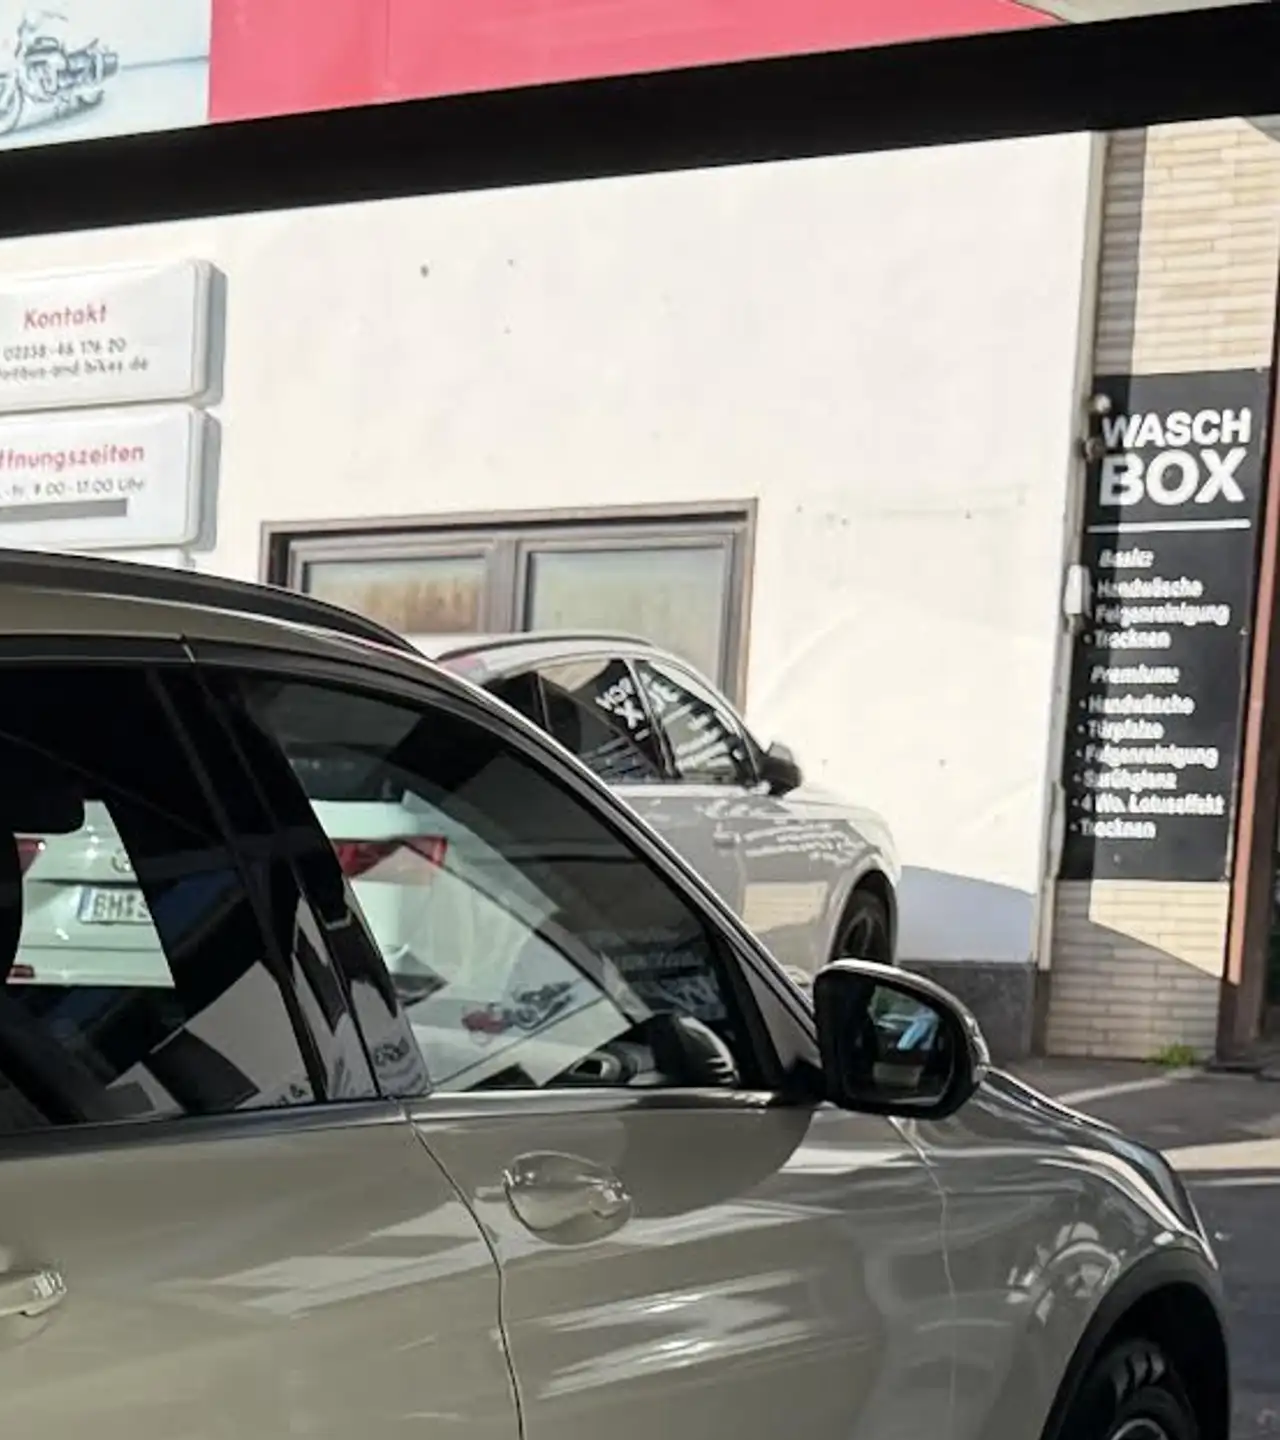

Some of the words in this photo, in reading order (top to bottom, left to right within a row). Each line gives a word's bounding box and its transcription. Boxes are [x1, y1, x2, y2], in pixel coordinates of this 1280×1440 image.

[23, 303, 108, 331] Kontakt
[1100, 407, 1252, 450] WASCH
[1099, 446, 1247, 506] BOX
